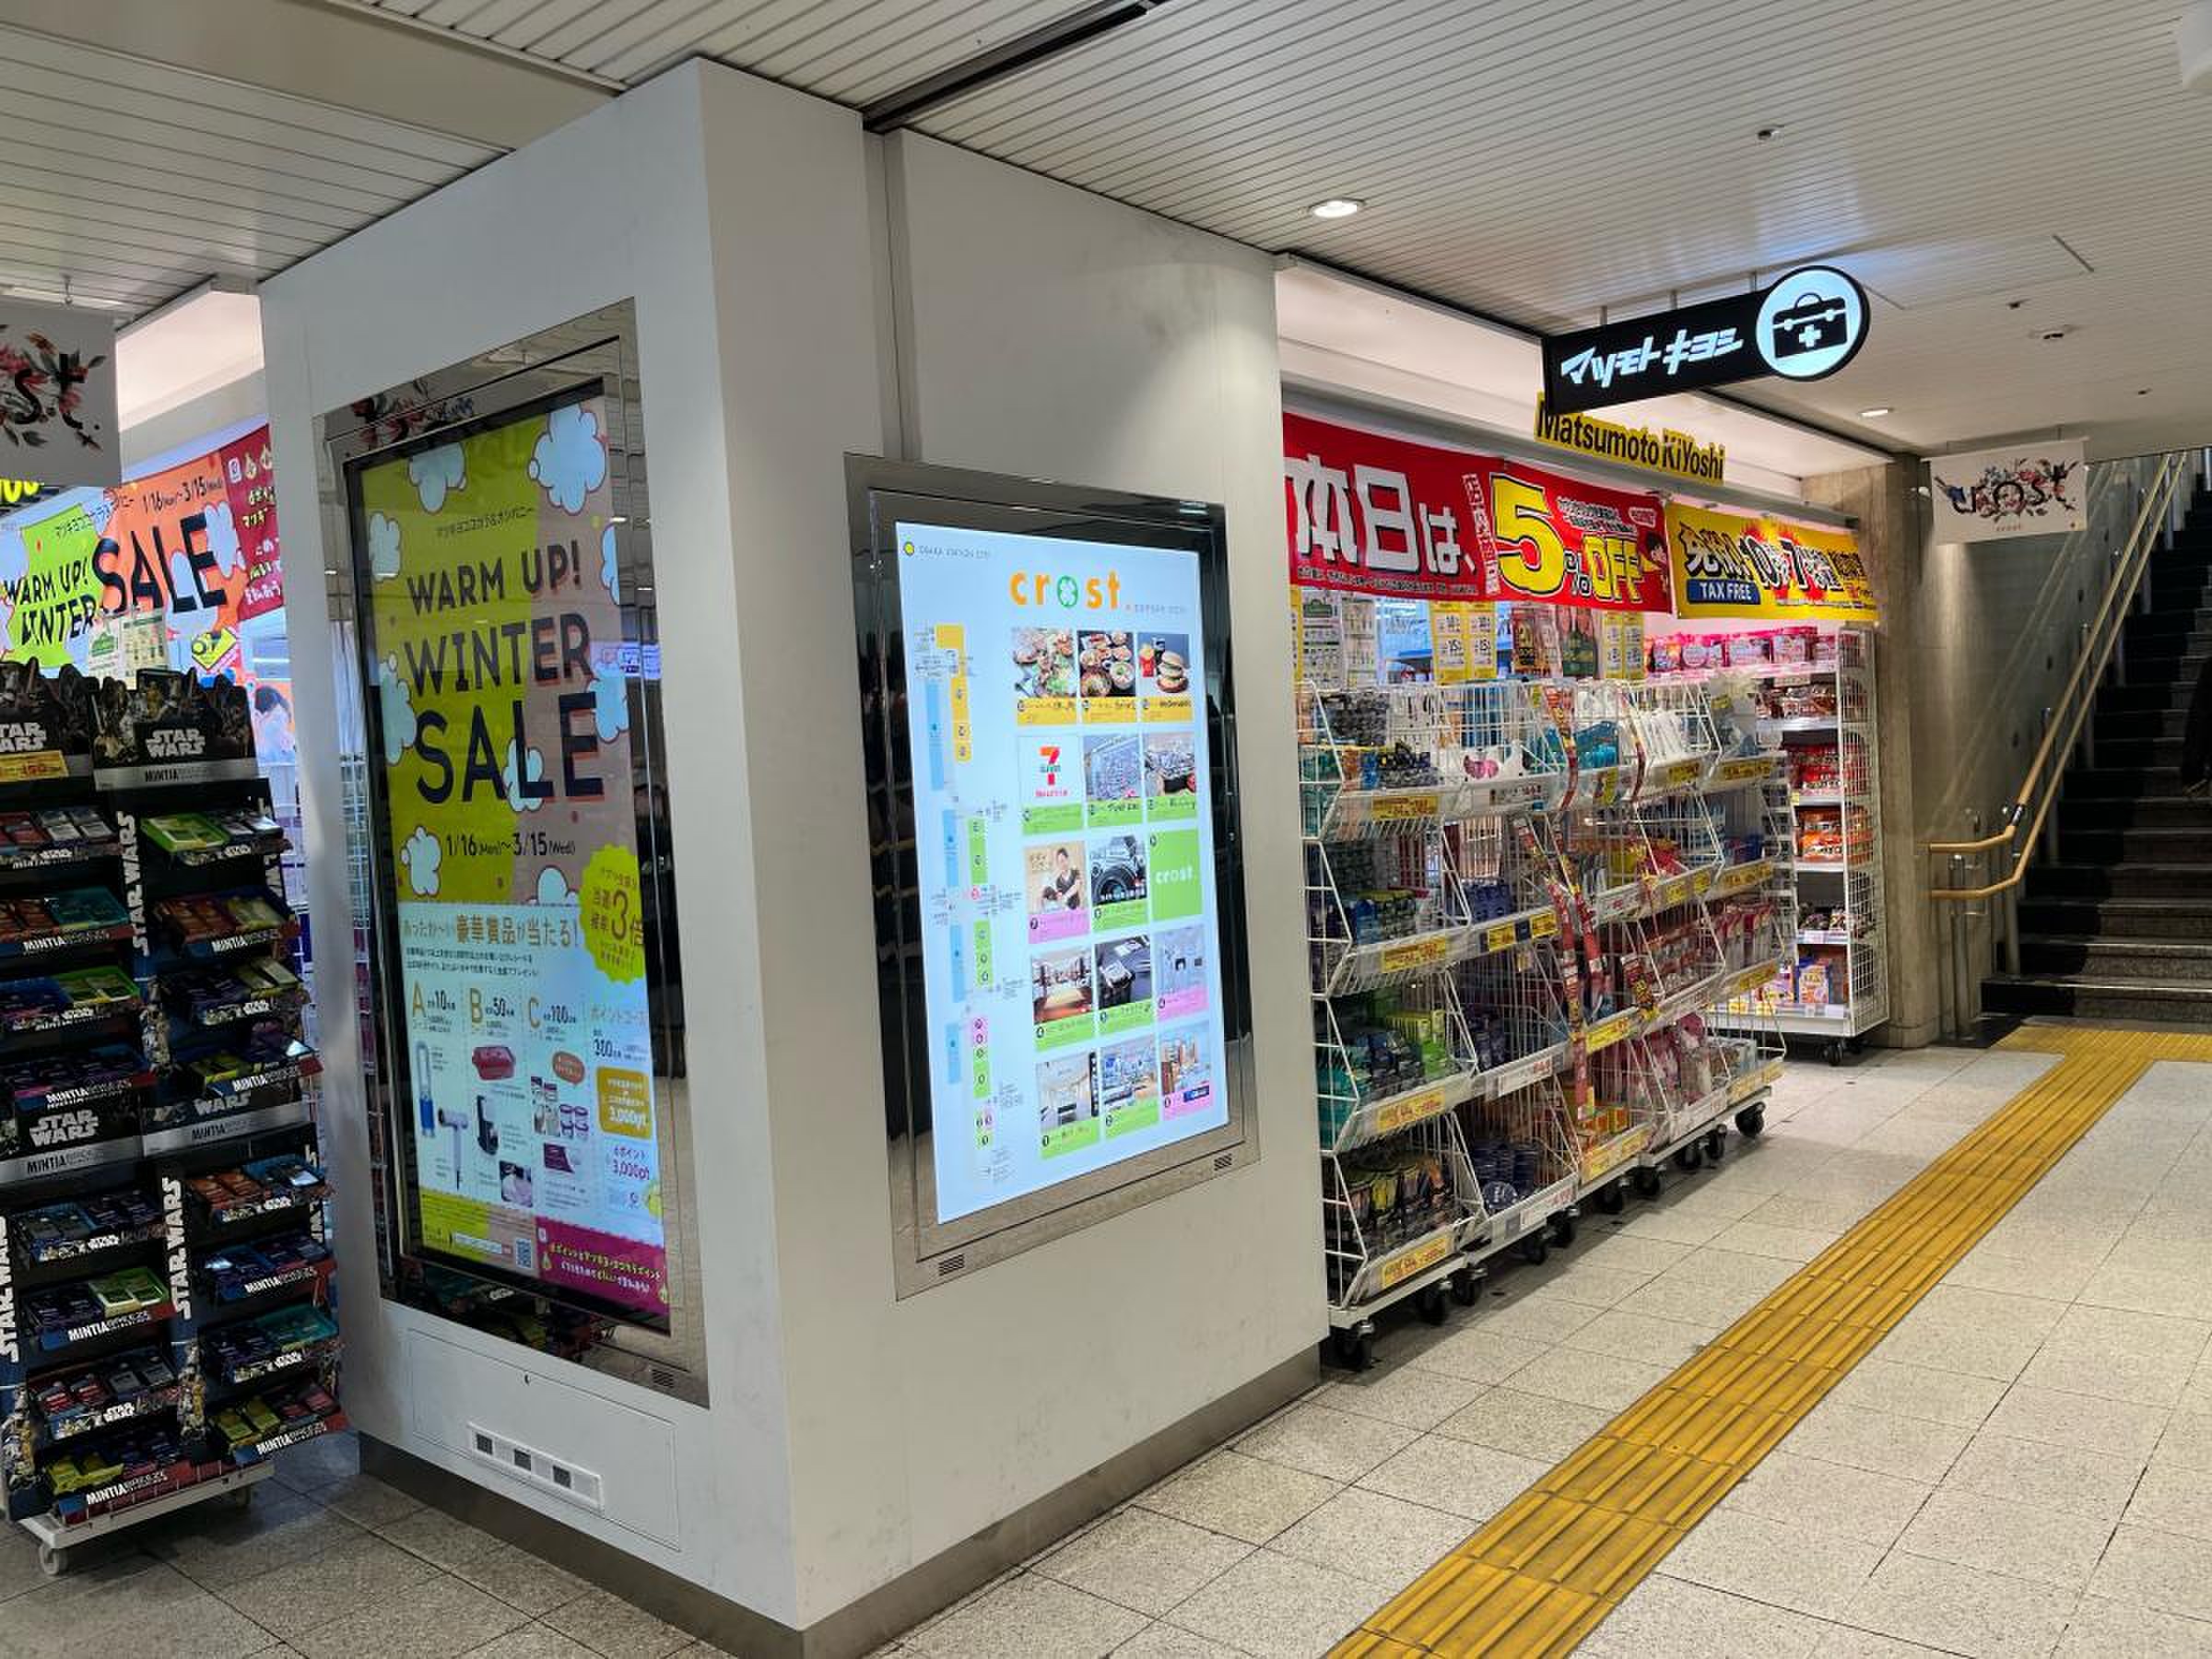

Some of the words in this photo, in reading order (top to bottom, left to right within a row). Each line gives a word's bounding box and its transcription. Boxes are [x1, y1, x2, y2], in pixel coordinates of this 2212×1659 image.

[1561, 328, 1744, 388] マツモトキヨシ
[1537, 401, 1659, 467] Matsumoto
[1662, 429, 1724, 480] KiYoshi
[3, 571, 56, 606] WARM
[59, 557, 88, 593] UP!
[92, 512, 228, 615] SALE
[406, 558, 505, 617] WARM
[521, 539, 582, 594] UP!
[1010, 570, 1121, 609] crost
[1699, 582, 1725, 600] TAX
[1726, 583, 1753, 601] FREE
[404, 613, 593, 698] WINTER
[415, 691, 605, 805] SALE
[23, 934, 65, 952] MINTIA
[46, 1086, 89, 1104] MINTIA
[30, 1124, 99, 1147] WARS
[38, 1109, 99, 1128] STAR
[28, 1156, 67, 1174] MINTIA
[162, 1176, 186, 1250] WARS
[170, 1247, 192, 1321] STAR
[68, 1319, 109, 1342] MINTIA
[88, 1482, 127, 1504] MINTIA
